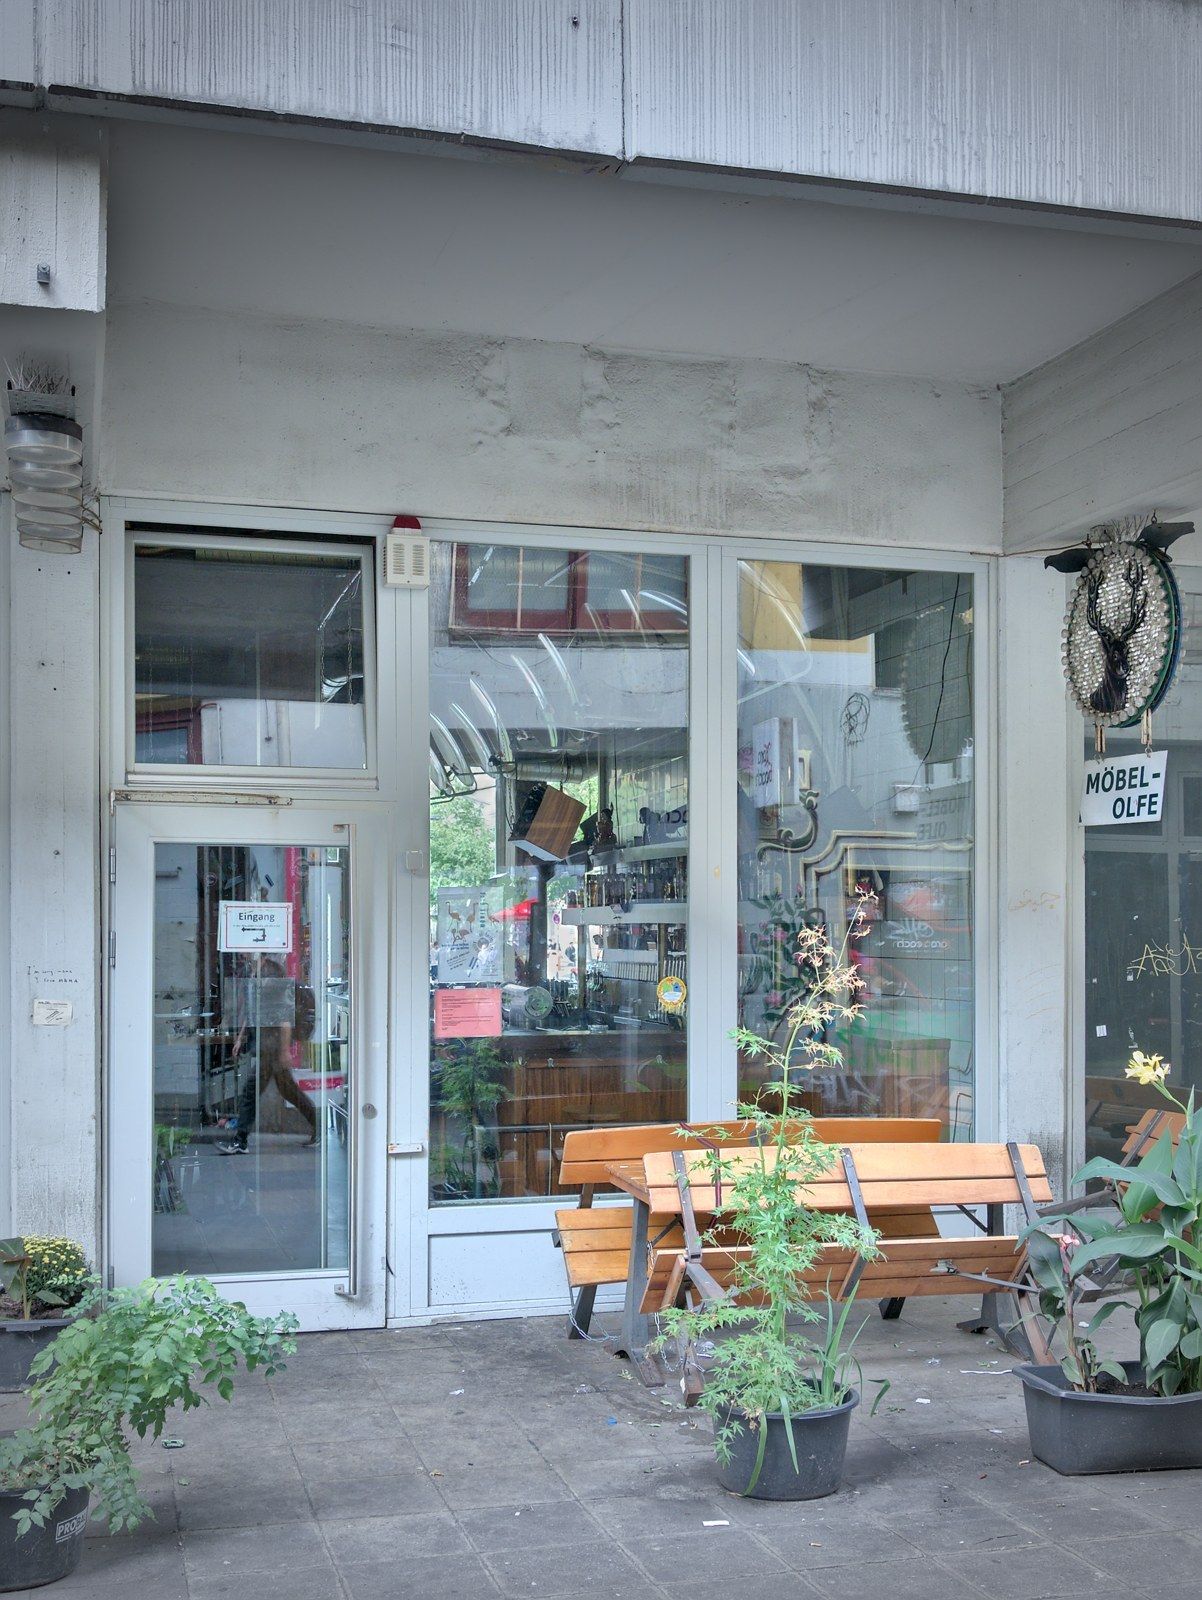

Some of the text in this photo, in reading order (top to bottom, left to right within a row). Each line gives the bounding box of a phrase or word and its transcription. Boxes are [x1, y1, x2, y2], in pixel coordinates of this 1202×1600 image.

[1086, 766, 1161, 795] MÖBEL-
[1112, 793, 1158, 819] OLFE
[238, 912, 275, 923] Eingang
